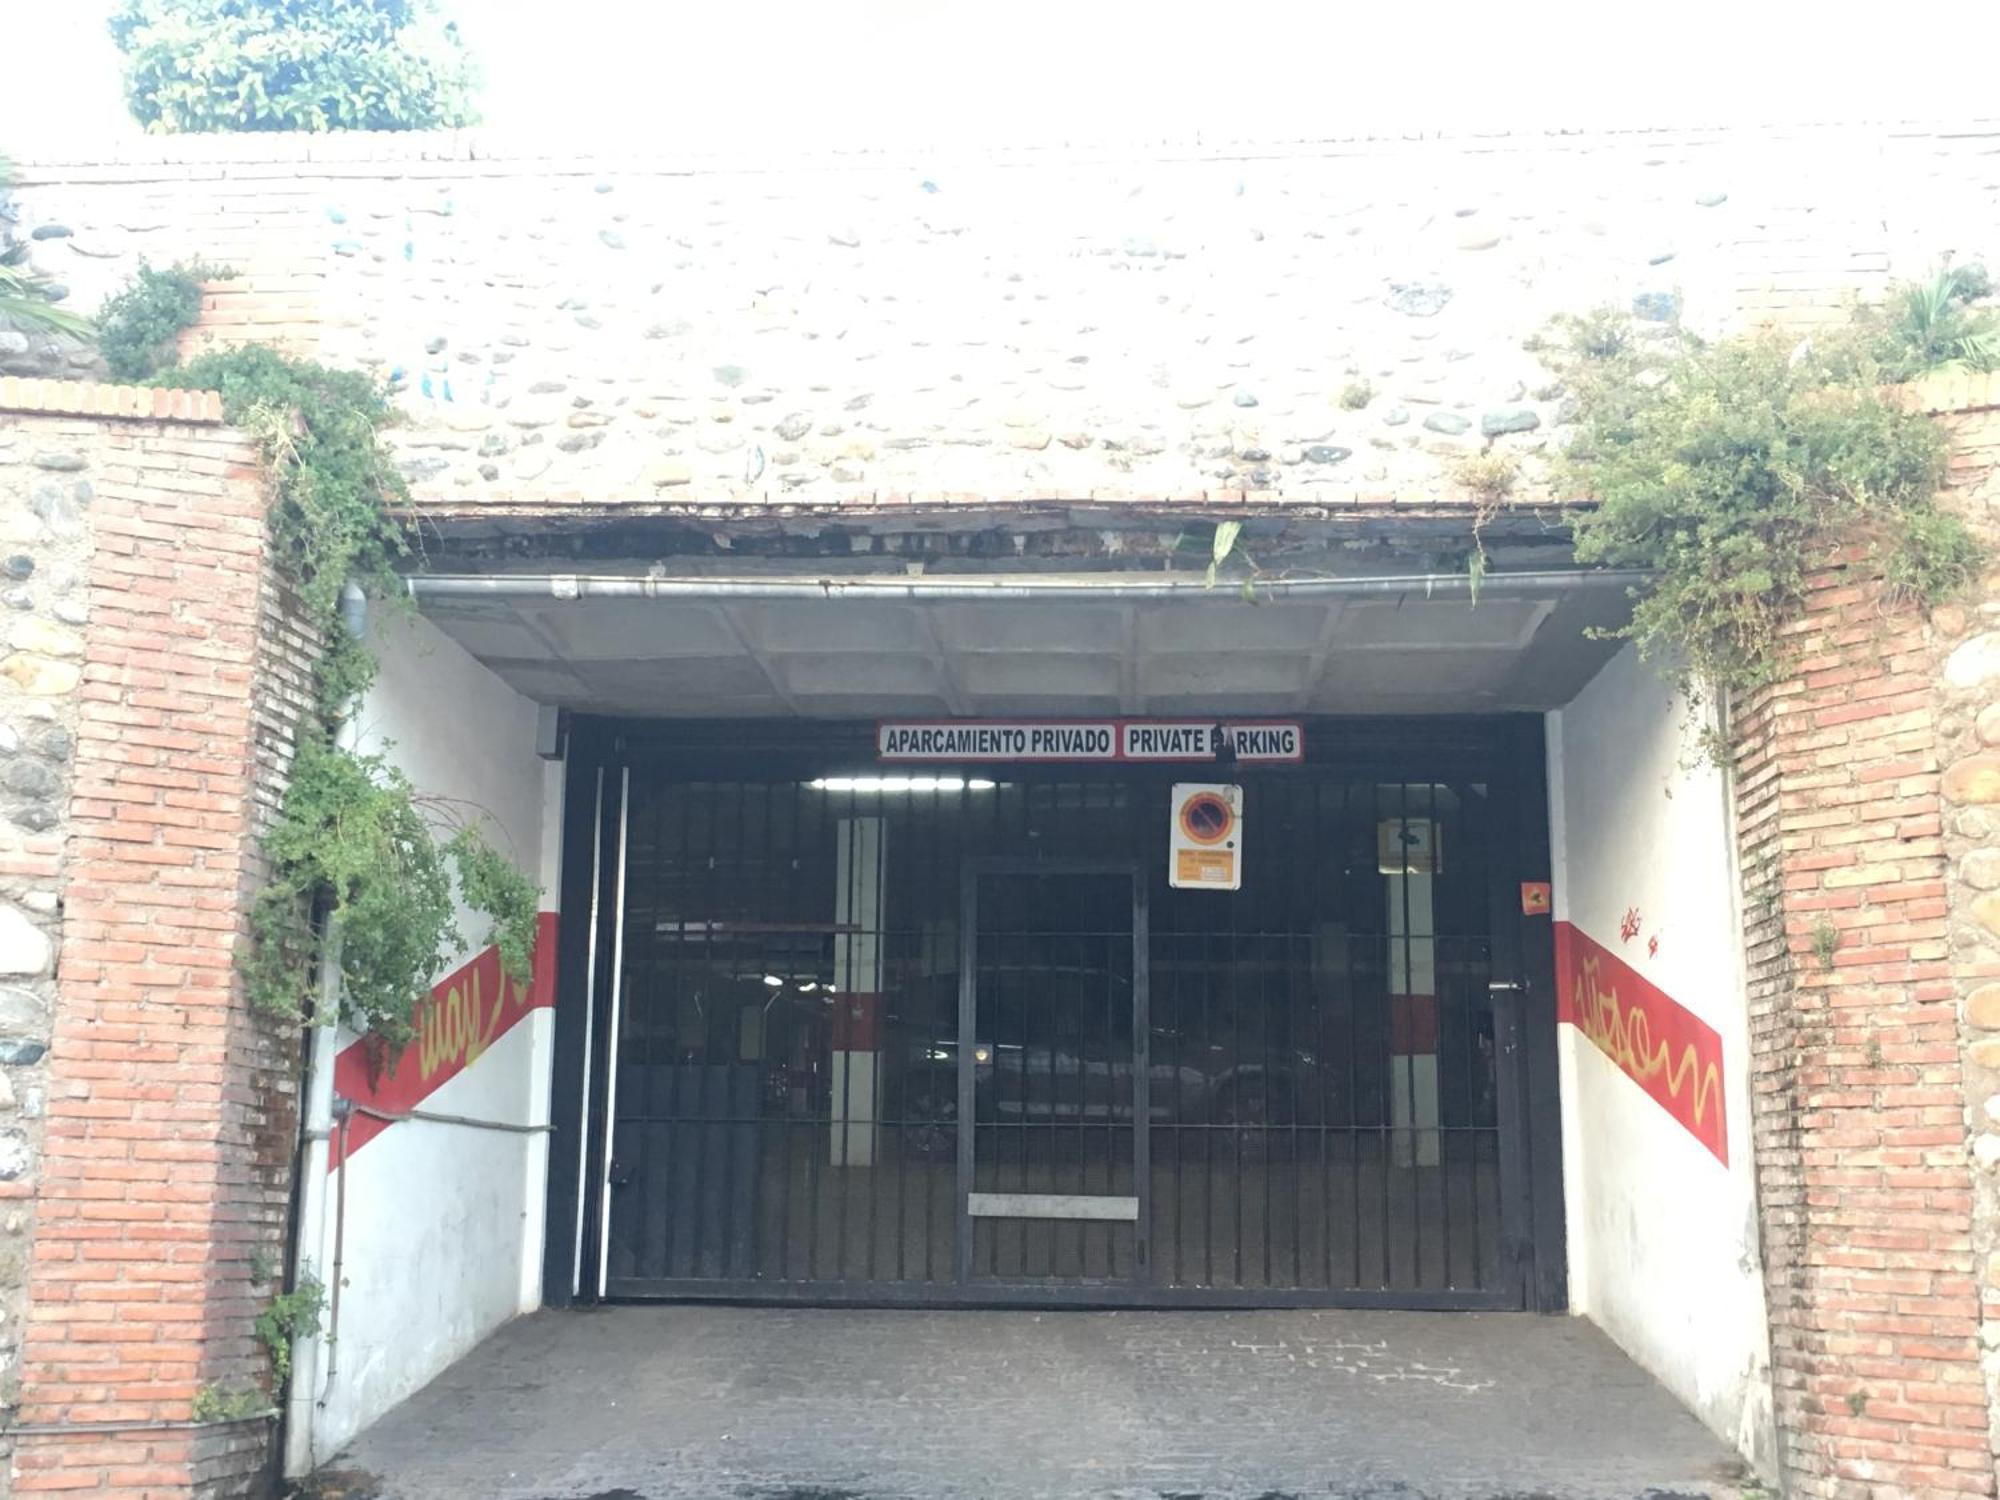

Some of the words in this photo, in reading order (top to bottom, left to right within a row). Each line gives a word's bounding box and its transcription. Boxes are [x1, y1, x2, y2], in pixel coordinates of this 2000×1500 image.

[886, 729, 1026, 754] APARCAMIENTO
[1031, 729, 1110, 753] PRIVADO
[1129, 729, 1204, 753] PRIVATE
